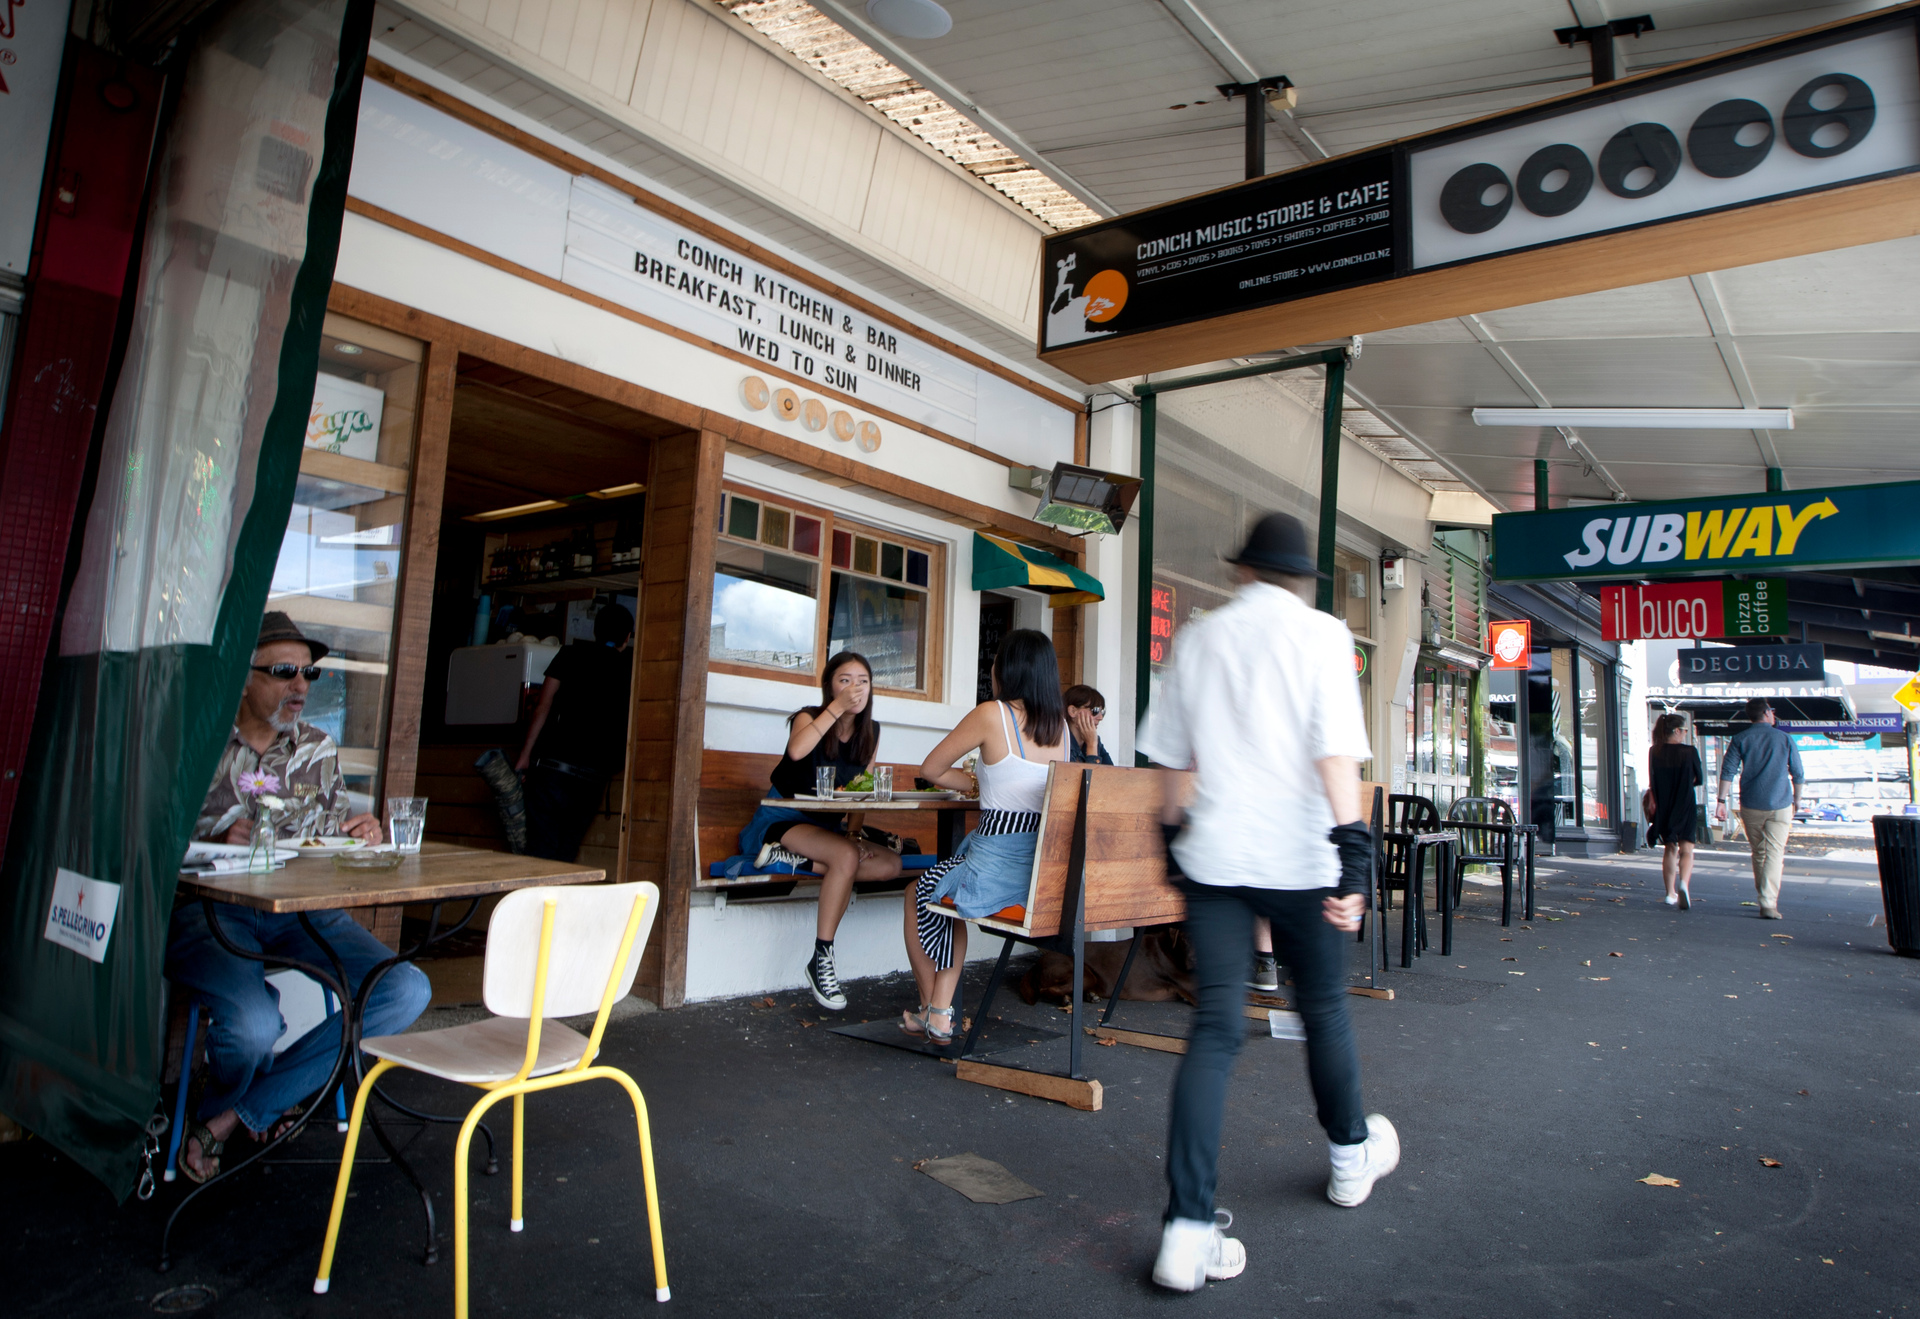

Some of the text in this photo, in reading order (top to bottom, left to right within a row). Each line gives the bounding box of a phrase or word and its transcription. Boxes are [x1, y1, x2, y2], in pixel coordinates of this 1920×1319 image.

[1137, 181, 1389, 260] CONCH MUSIC STORE & CAFE
[1137, 266, 1160, 277] VINYL
[1166, 260, 1181, 271] CDS
[1188, 253, 1210, 265] DVDS
[1217, 245, 1243, 258] BOOKS
[1251, 239, 1270, 250] TOYS
[1284, 227, 1314, 242] SHIRTS
[1322, 217, 1357, 232] COFFEE
[1365, 209, 1390, 222] FOOD
[1239, 275, 1272, 289] ONLINE
[1272, 268, 1299, 282] STORE
[1308, 247, 1391, 274] WWW.CONCH.CO.NZ
[634, 252, 921, 392] BREAKFAST, LUNCH & DINNER
[677, 239, 897, 354] CONCH KITCHEN & BAR
[738, 327, 857, 393] WED TO SUN
[1563, 497, 1839, 570] SUBWAY
[1614, 586, 1708, 639] il buco
[1736, 592, 1755, 634] pizza
[1753, 581, 1769, 633] coffee
[1690, 654, 1810, 673] DECJUBA
[1811, 686, 1844, 696] WHILE
[1839, 717, 1897, 727] BOOKSHOP
[51, 904, 105, 941] S.PELLEGRINO
